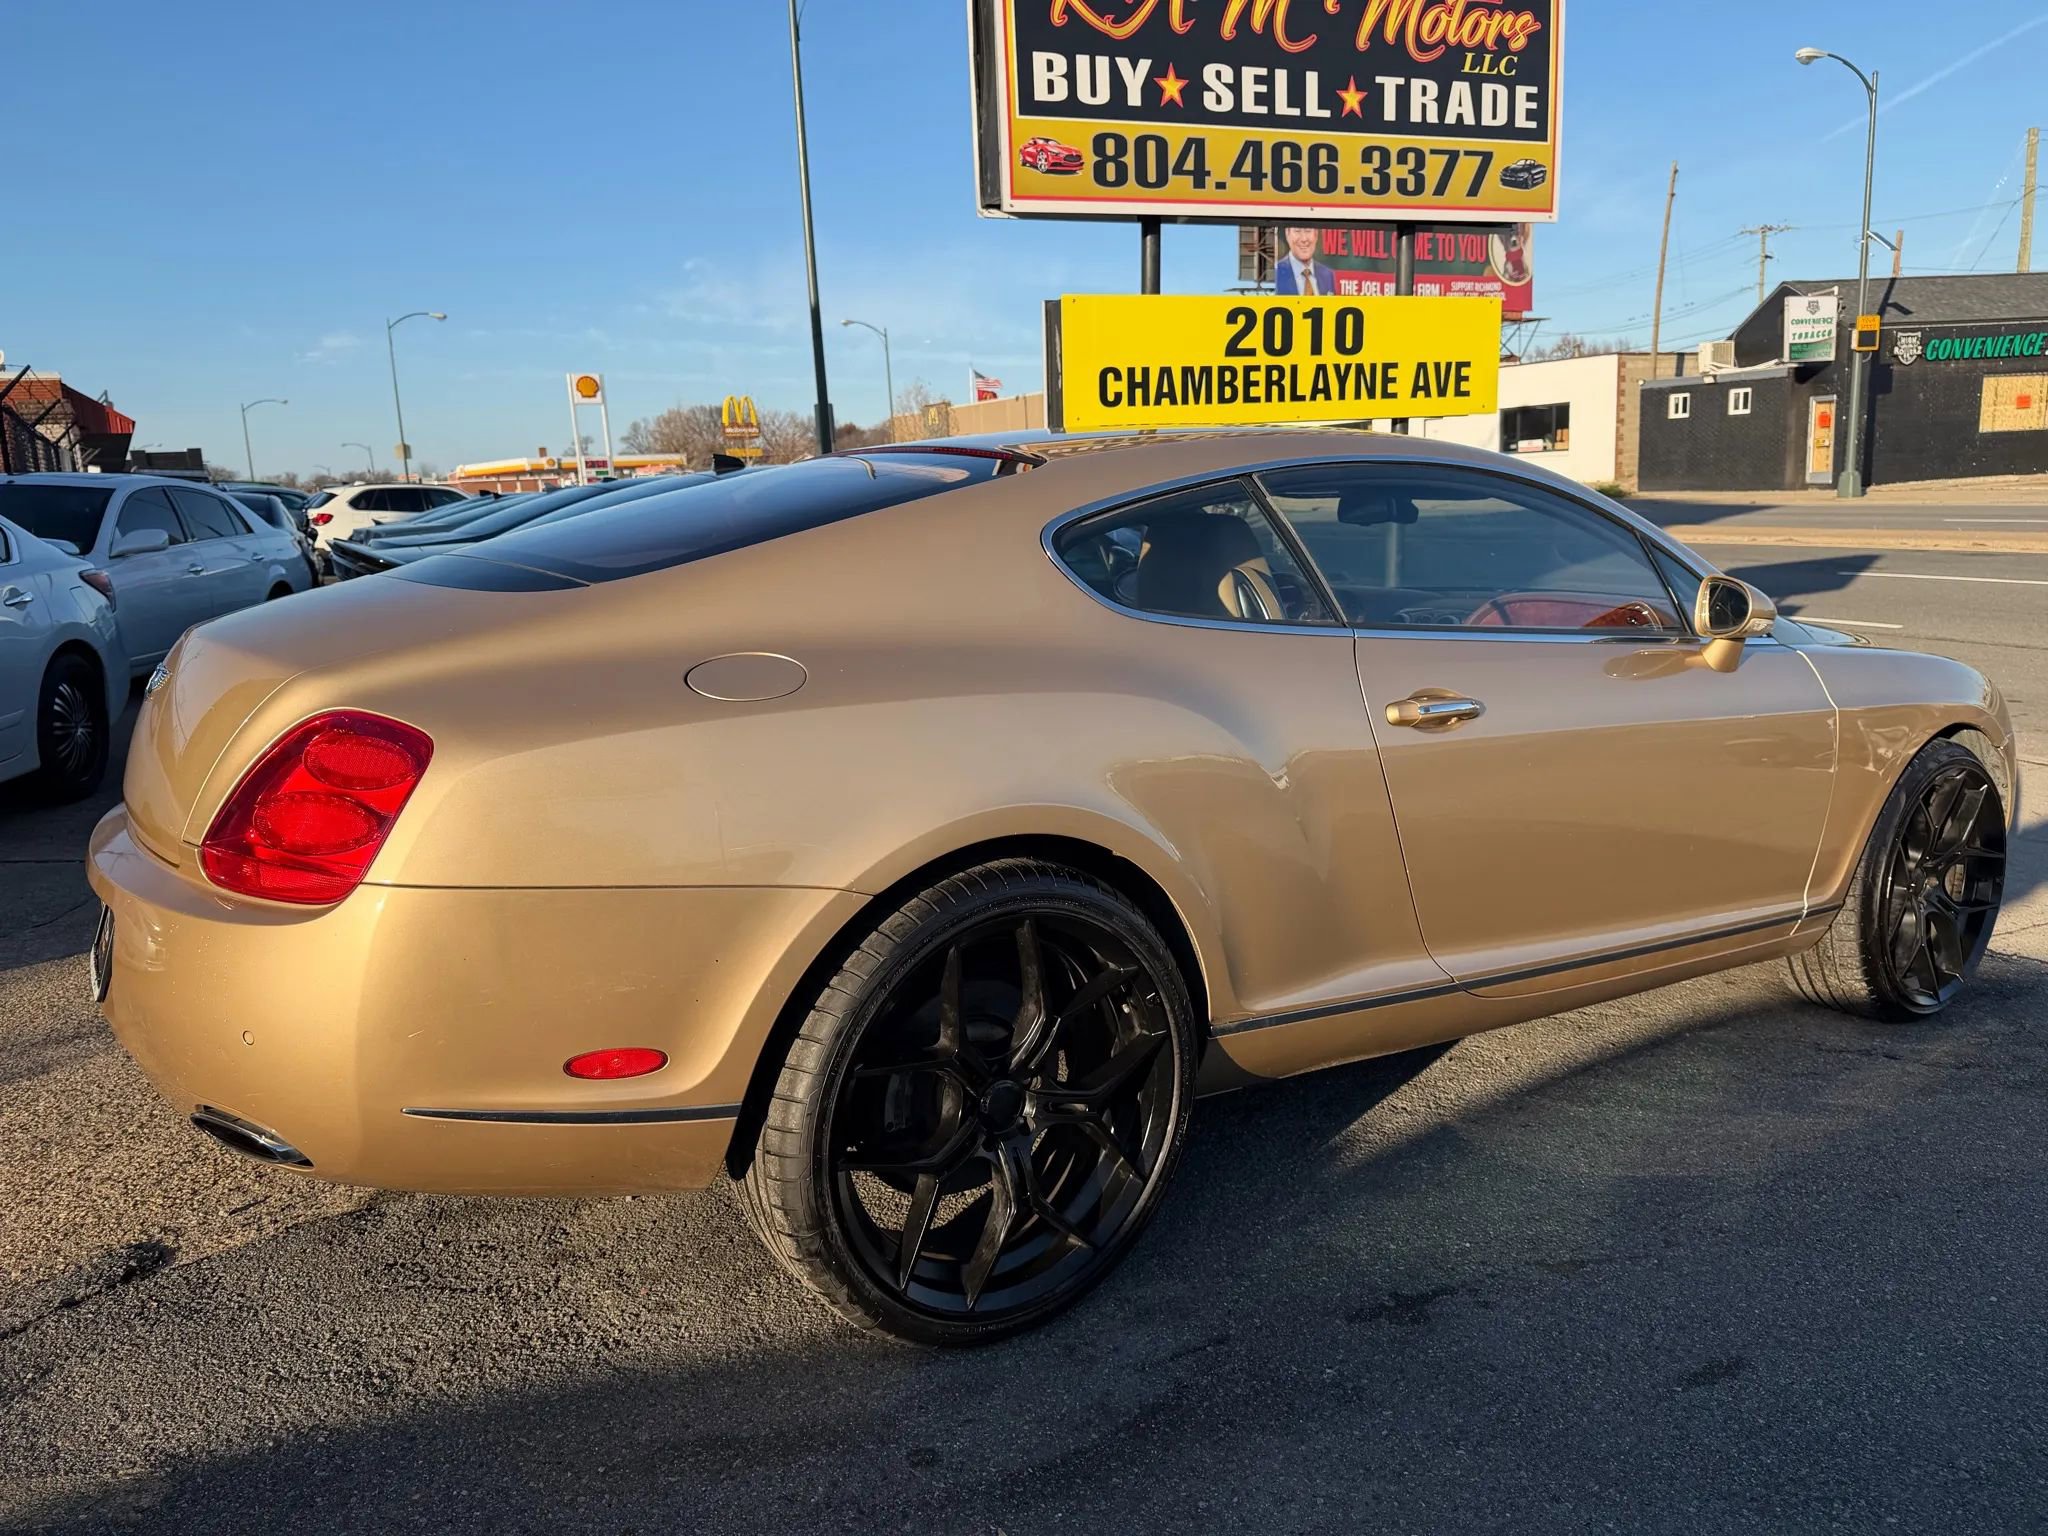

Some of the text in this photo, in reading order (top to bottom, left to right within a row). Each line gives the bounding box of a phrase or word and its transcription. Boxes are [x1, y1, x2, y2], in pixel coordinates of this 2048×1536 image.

[1461, 52, 1518, 76] LLC
[1032, 50, 1540, 129] BUY SELL TRADE
[1091, 132, 1494, 198] 804.466.3377
[1322, 229, 1348, 256] WE
[1351, 230, 1389, 260] WILL
[1436, 233, 1456, 262] TO
[1458, 234, 1488, 263] YOU
[1340, 279, 1359, 296] THE
[1360, 280, 1383, 297] JOEL
[1417, 282, 1440, 297] FIRM
[1224, 306, 1365, 358] 2010
[1791, 329, 1833, 341] TOBACCO
[1925, 332, 2048, 361] CONVENIENCE
[1098, 361, 1472, 408] CHAMBERLAYNE AVE
